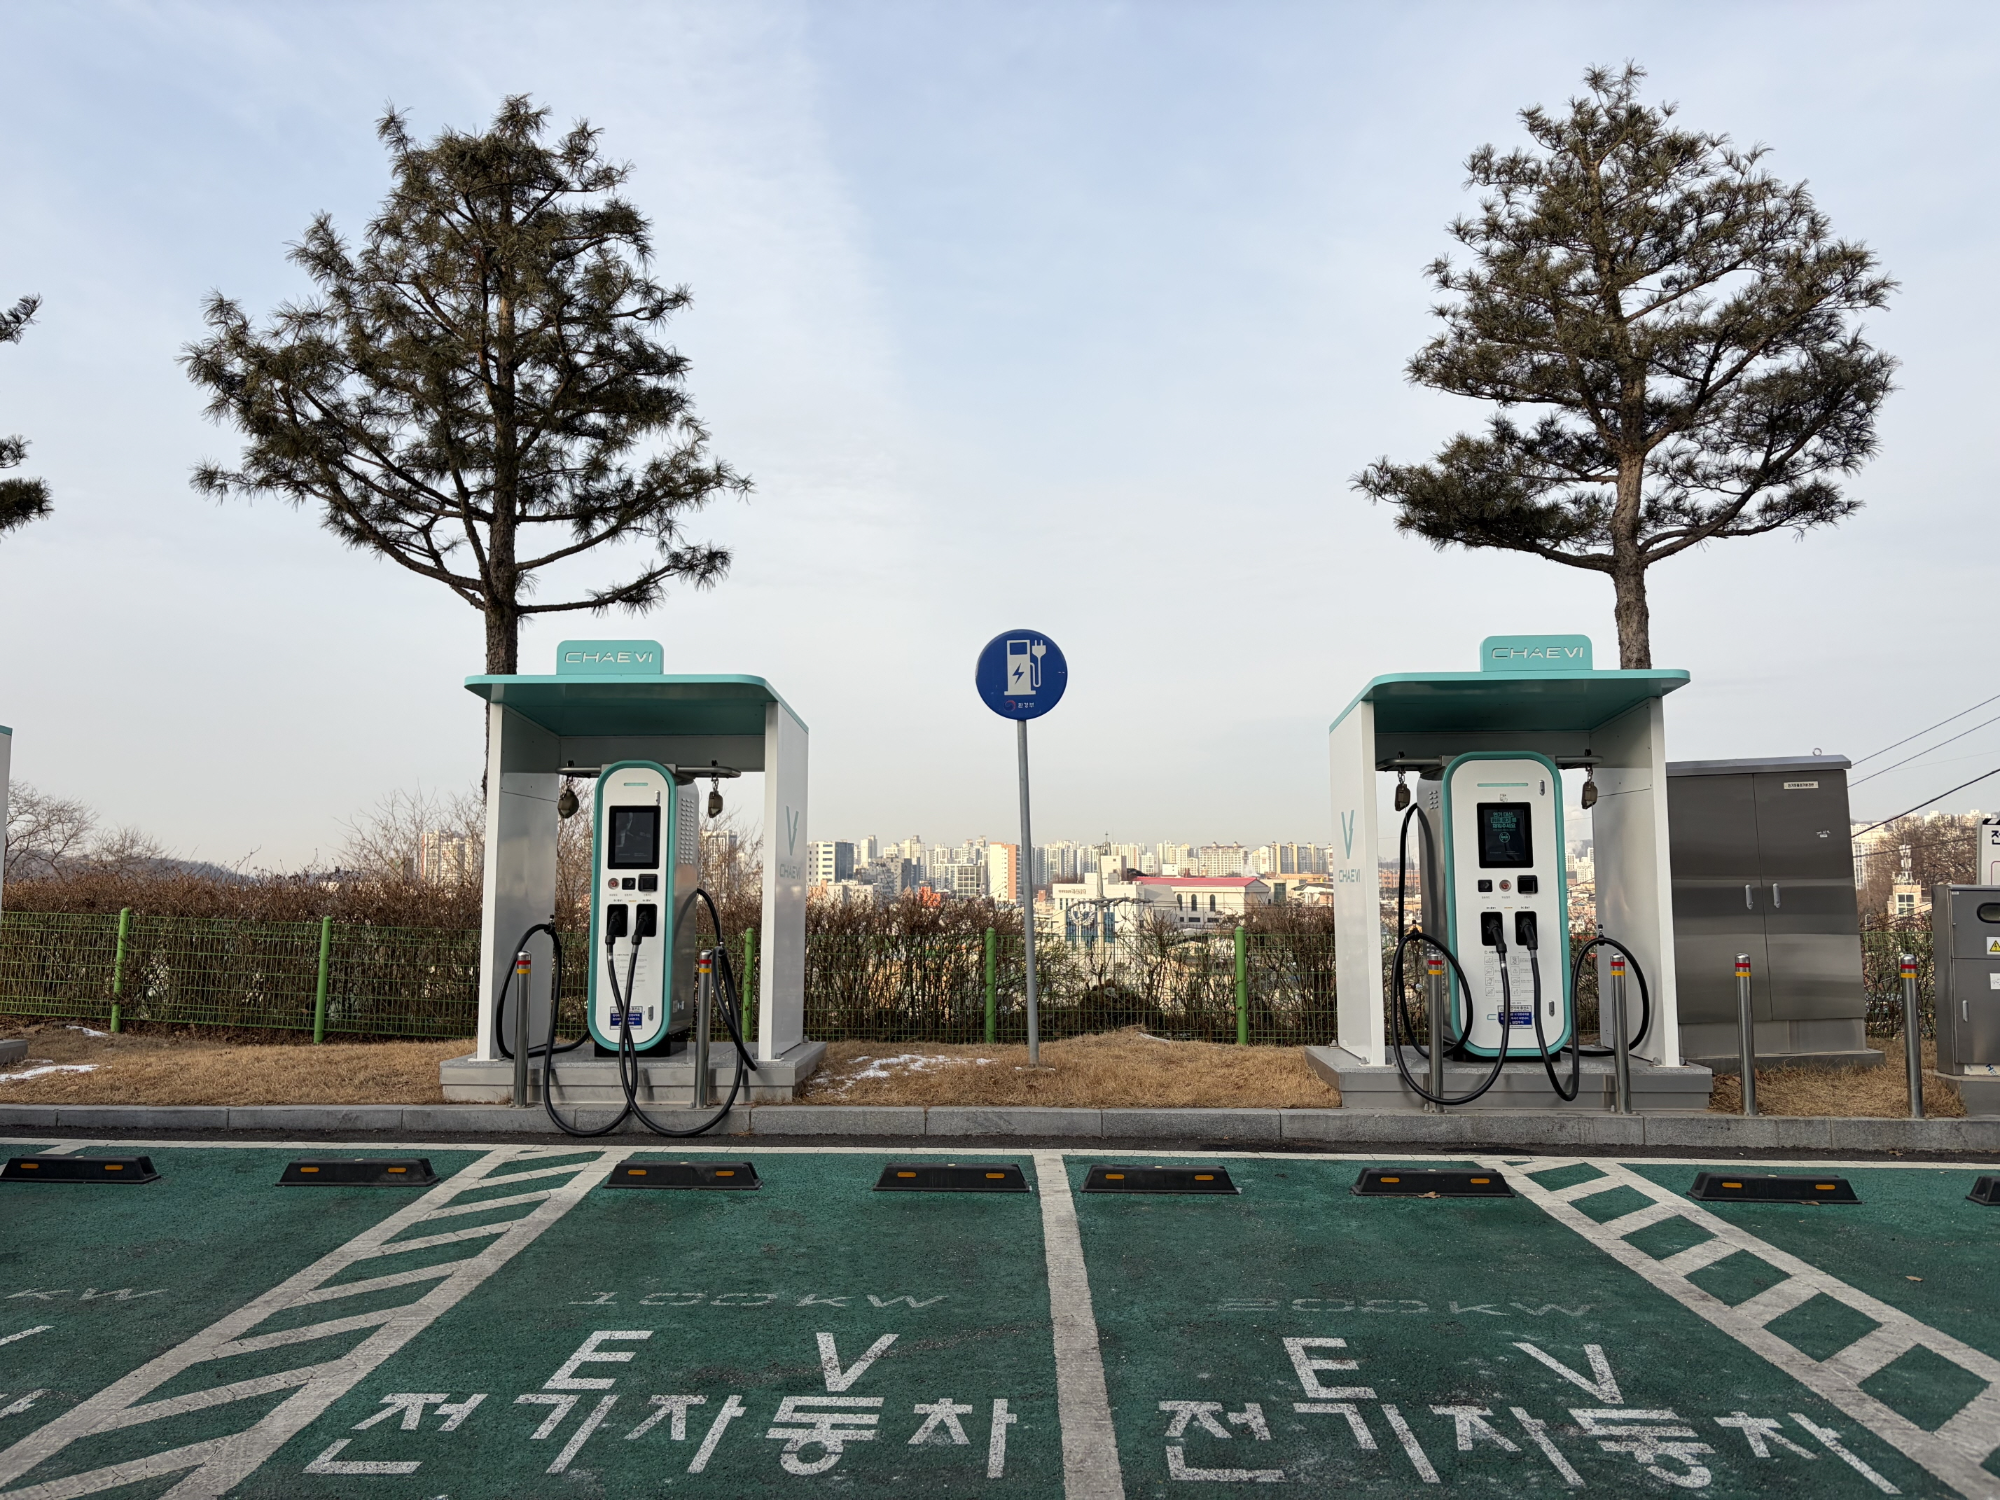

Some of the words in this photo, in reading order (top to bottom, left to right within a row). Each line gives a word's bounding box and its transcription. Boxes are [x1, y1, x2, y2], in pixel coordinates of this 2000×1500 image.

[564, 651, 653, 664] CHAEVI
[1491, 646, 1584, 660] CHAEVI
[779, 863, 801, 880] CHAEVI
[1338, 869, 1361, 883] CHAEVI
[303, 1393, 1018, 1479] 전기자동차
[1157, 1400, 1902, 1495] 전기자동차
